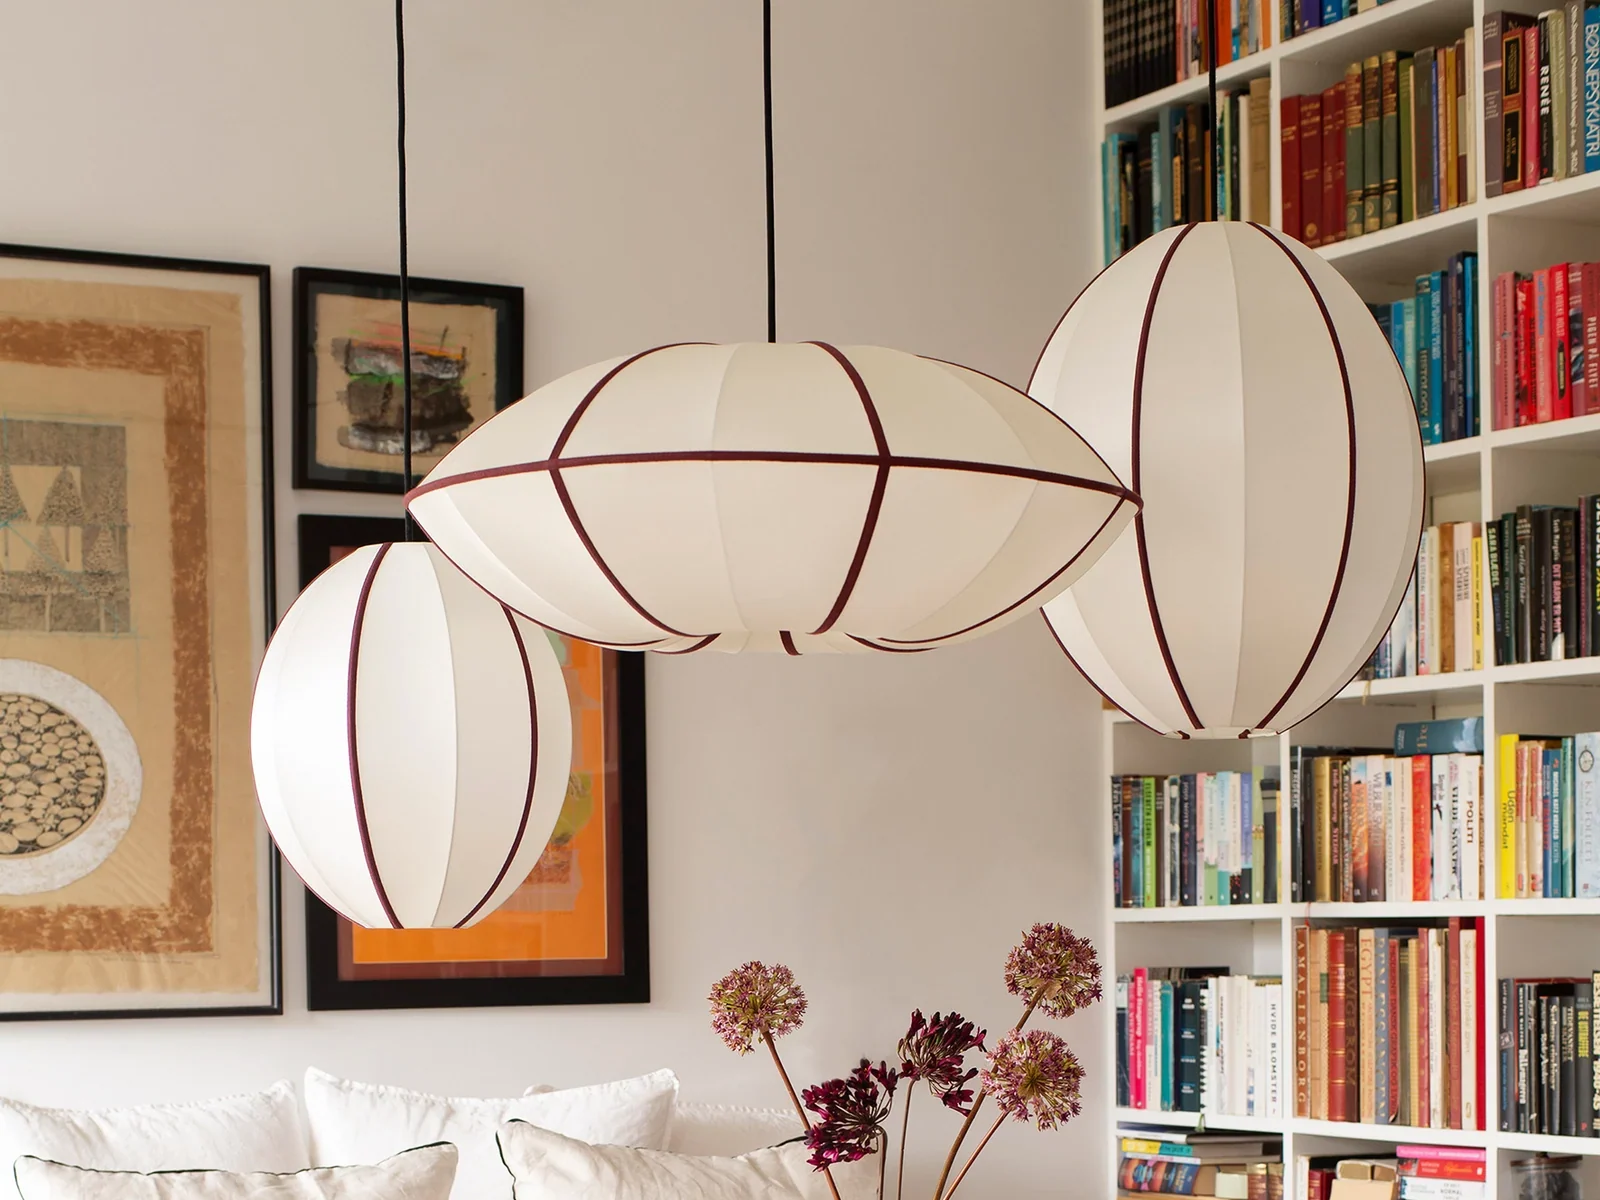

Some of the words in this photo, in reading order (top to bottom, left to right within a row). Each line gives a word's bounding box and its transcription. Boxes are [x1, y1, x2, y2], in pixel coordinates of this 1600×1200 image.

[1585, 23, 1600, 157] BØRNEPSYKIATRI
[1587, 316, 1598, 344] PIGEN
[1588, 348, 1598, 360] PÅ
[1418, 350, 1429, 417] HISTOLOGY
[1588, 363, 1598, 388] FLYET
[1487, 528, 1498, 551] SARA
[1489, 552, 1501, 588] BLÆDEL
[1552, 563, 1562, 577] DIT
[1552, 580, 1562, 602] BARN
[1553, 604, 1562, 615] ER
[1553, 617, 1562, 633] MIT
[1372, 772, 1382, 810] WILBUR
[1507, 790, 1517, 823] Uden
[1466, 801, 1474, 843] POLITI
[1360, 938, 1373, 1000] EGYPT
[1344, 967, 1356, 1032] EVIGE
[1297, 940, 1306, 1103] AMALIENBORG
[1344, 1035, 1356, 1087] ROM
